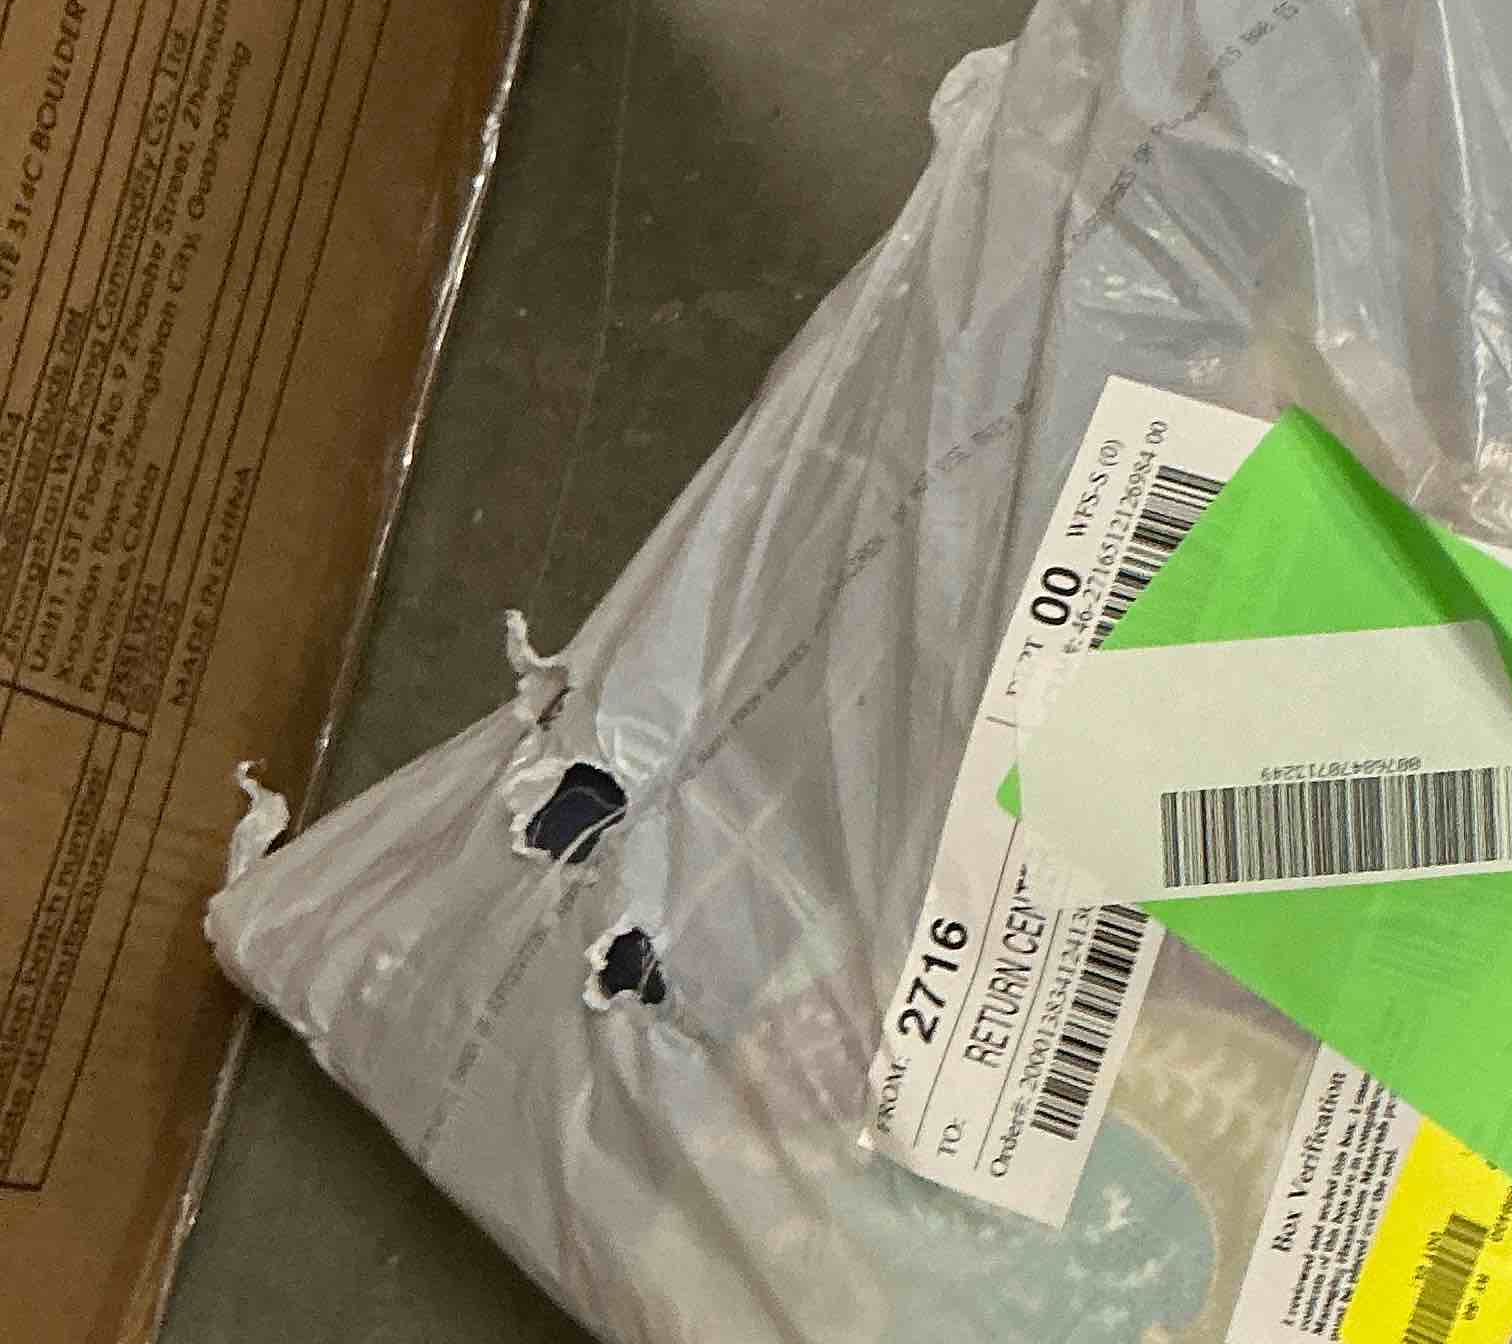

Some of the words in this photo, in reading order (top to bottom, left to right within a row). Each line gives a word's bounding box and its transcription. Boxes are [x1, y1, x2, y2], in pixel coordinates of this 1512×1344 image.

[6, 153, 43, 238] 314C
[1030, 566, 1082, 627] 00
[896, 917, 968, 1044] 2716
[962, 959, 1032, 1068] RETURN
[1272, 1211, 1303, 1252] Box
[1288, 1072, 1346, 1198] Verification
